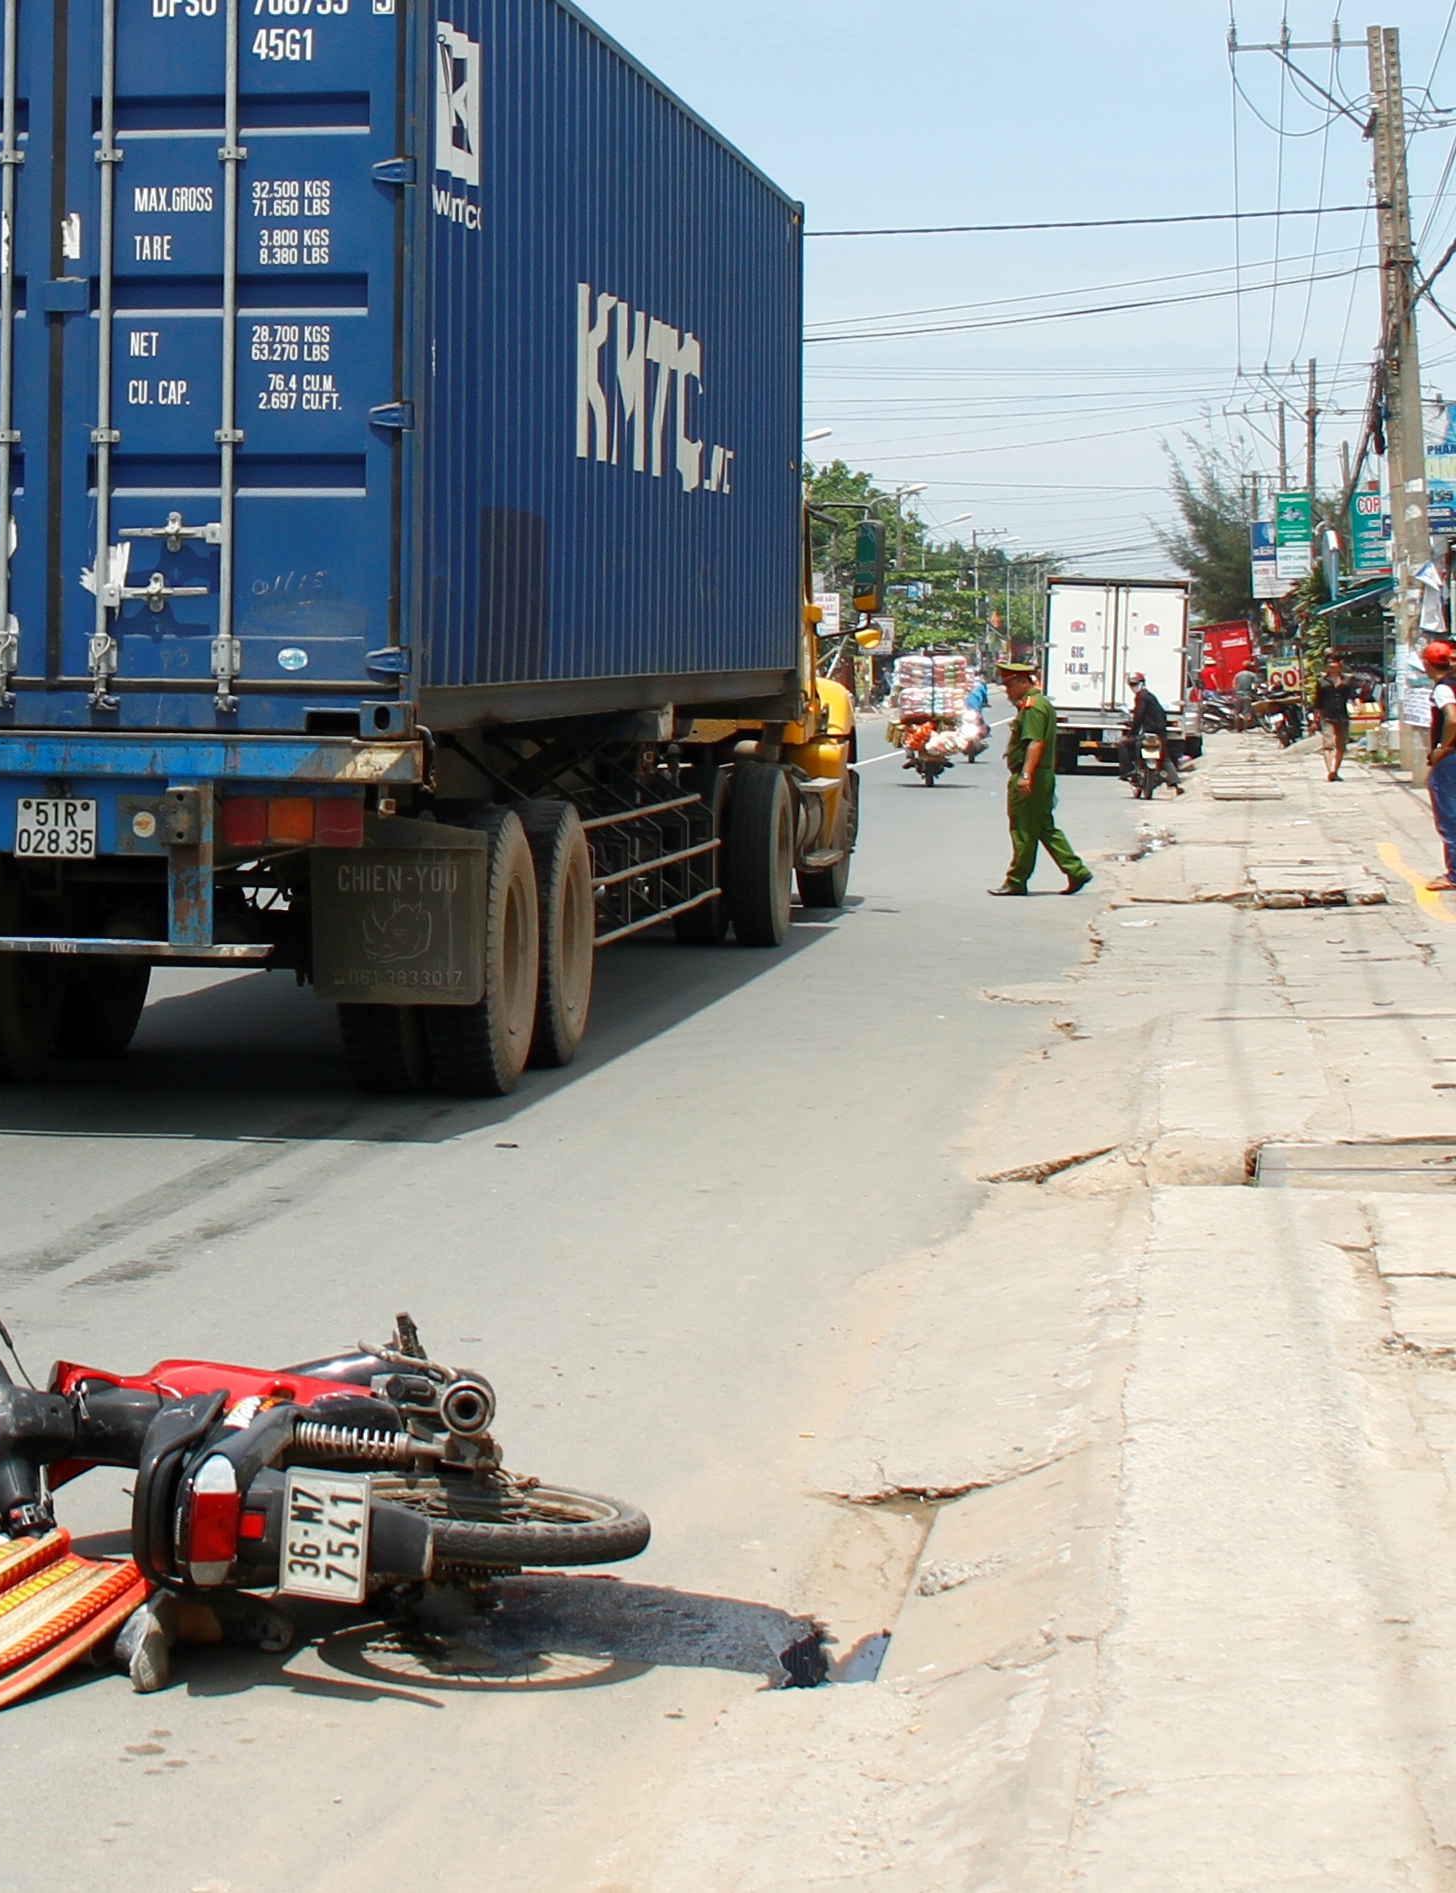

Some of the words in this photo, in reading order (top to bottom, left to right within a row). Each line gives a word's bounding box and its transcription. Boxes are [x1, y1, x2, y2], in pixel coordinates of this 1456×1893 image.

[252, 28, 313, 60] 45G1
[134, 187, 213, 212] MAX.GROSS
[252, 181, 299, 198] 32.500
[304, 180, 331, 198] KGS
[252, 200, 299, 217] 71.650
[304, 199, 331, 216] LBS
[134, 235, 172, 261] TARE
[259, 230, 298, 246] 3.800
[304, 229, 330, 246] KGS
[259, 248, 298, 265] 8.380
[303, 248, 330, 265] LBS
[130, 331, 159, 358] NET
[252, 325, 299, 343] 28.700
[304, 325, 330, 343] KGS
[251, 344, 299, 362] 63.270
[303, 344, 330, 362] LBS
[128, 380, 154, 406] CU.
[158, 380, 191, 406] CAP.
[268, 374, 297, 391] 76.4
[576, 281, 704, 494] KMTC
[258, 393, 297, 410] 2.697
[1356, 495, 1381, 515] COP
[35, 802, 78, 828] 51R
[17, 831, 94, 855] 028.35
[287, 1486, 325, 1577] 36-M7
[324, 1493, 364, 1583] 7541
